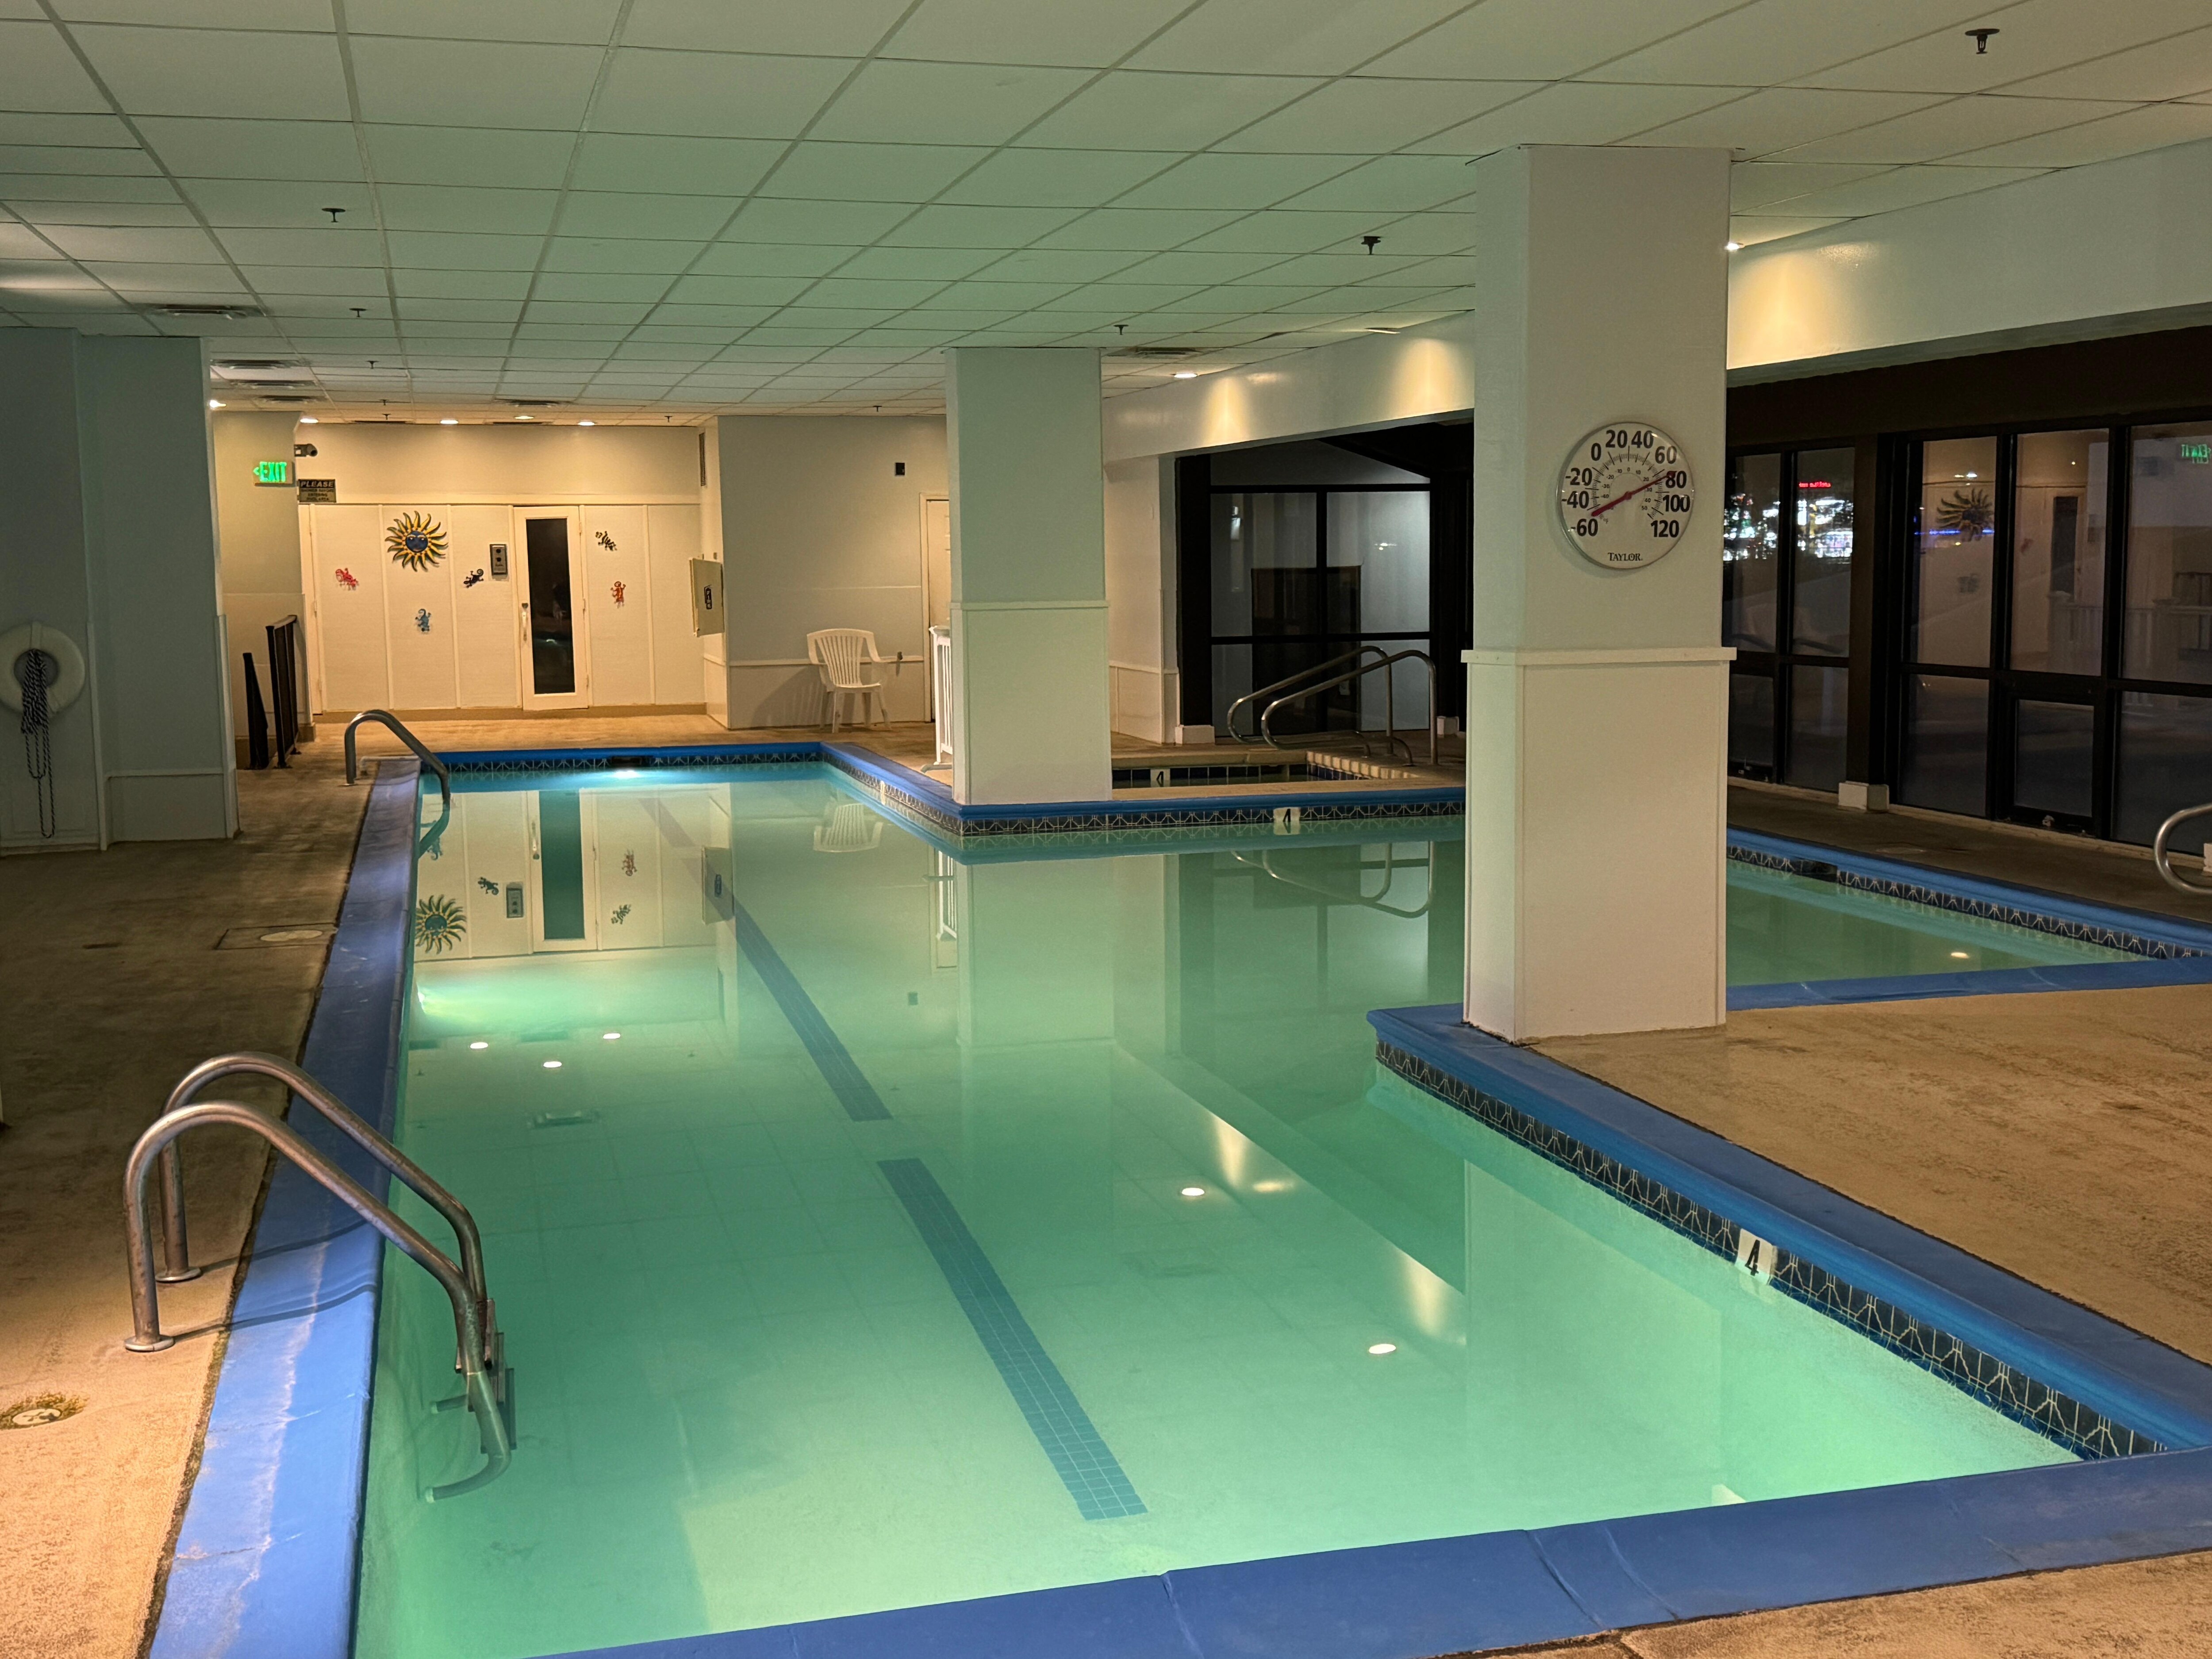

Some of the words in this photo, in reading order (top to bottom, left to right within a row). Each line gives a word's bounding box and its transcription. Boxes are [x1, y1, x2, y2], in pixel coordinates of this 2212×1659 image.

[1606, 430, 1628, 448] 20
[1631, 430, 1654, 449] 40
[1591, 443, 1601, 461] 0
[1655, 446, 1677, 464] 60
[259, 461, 287, 483] EXIT
[1566, 468, 1592, 486] -20
[1666, 471, 1687, 489] 80
[1562, 491, 1589, 509] -40
[1663, 495, 1690, 512] 100
[1571, 518, 1598, 536] -60
[1651, 520, 1679, 538] 120
[1607, 553, 1641, 561] TAYLOR
[1745, 1239, 1760, 1276] 4
